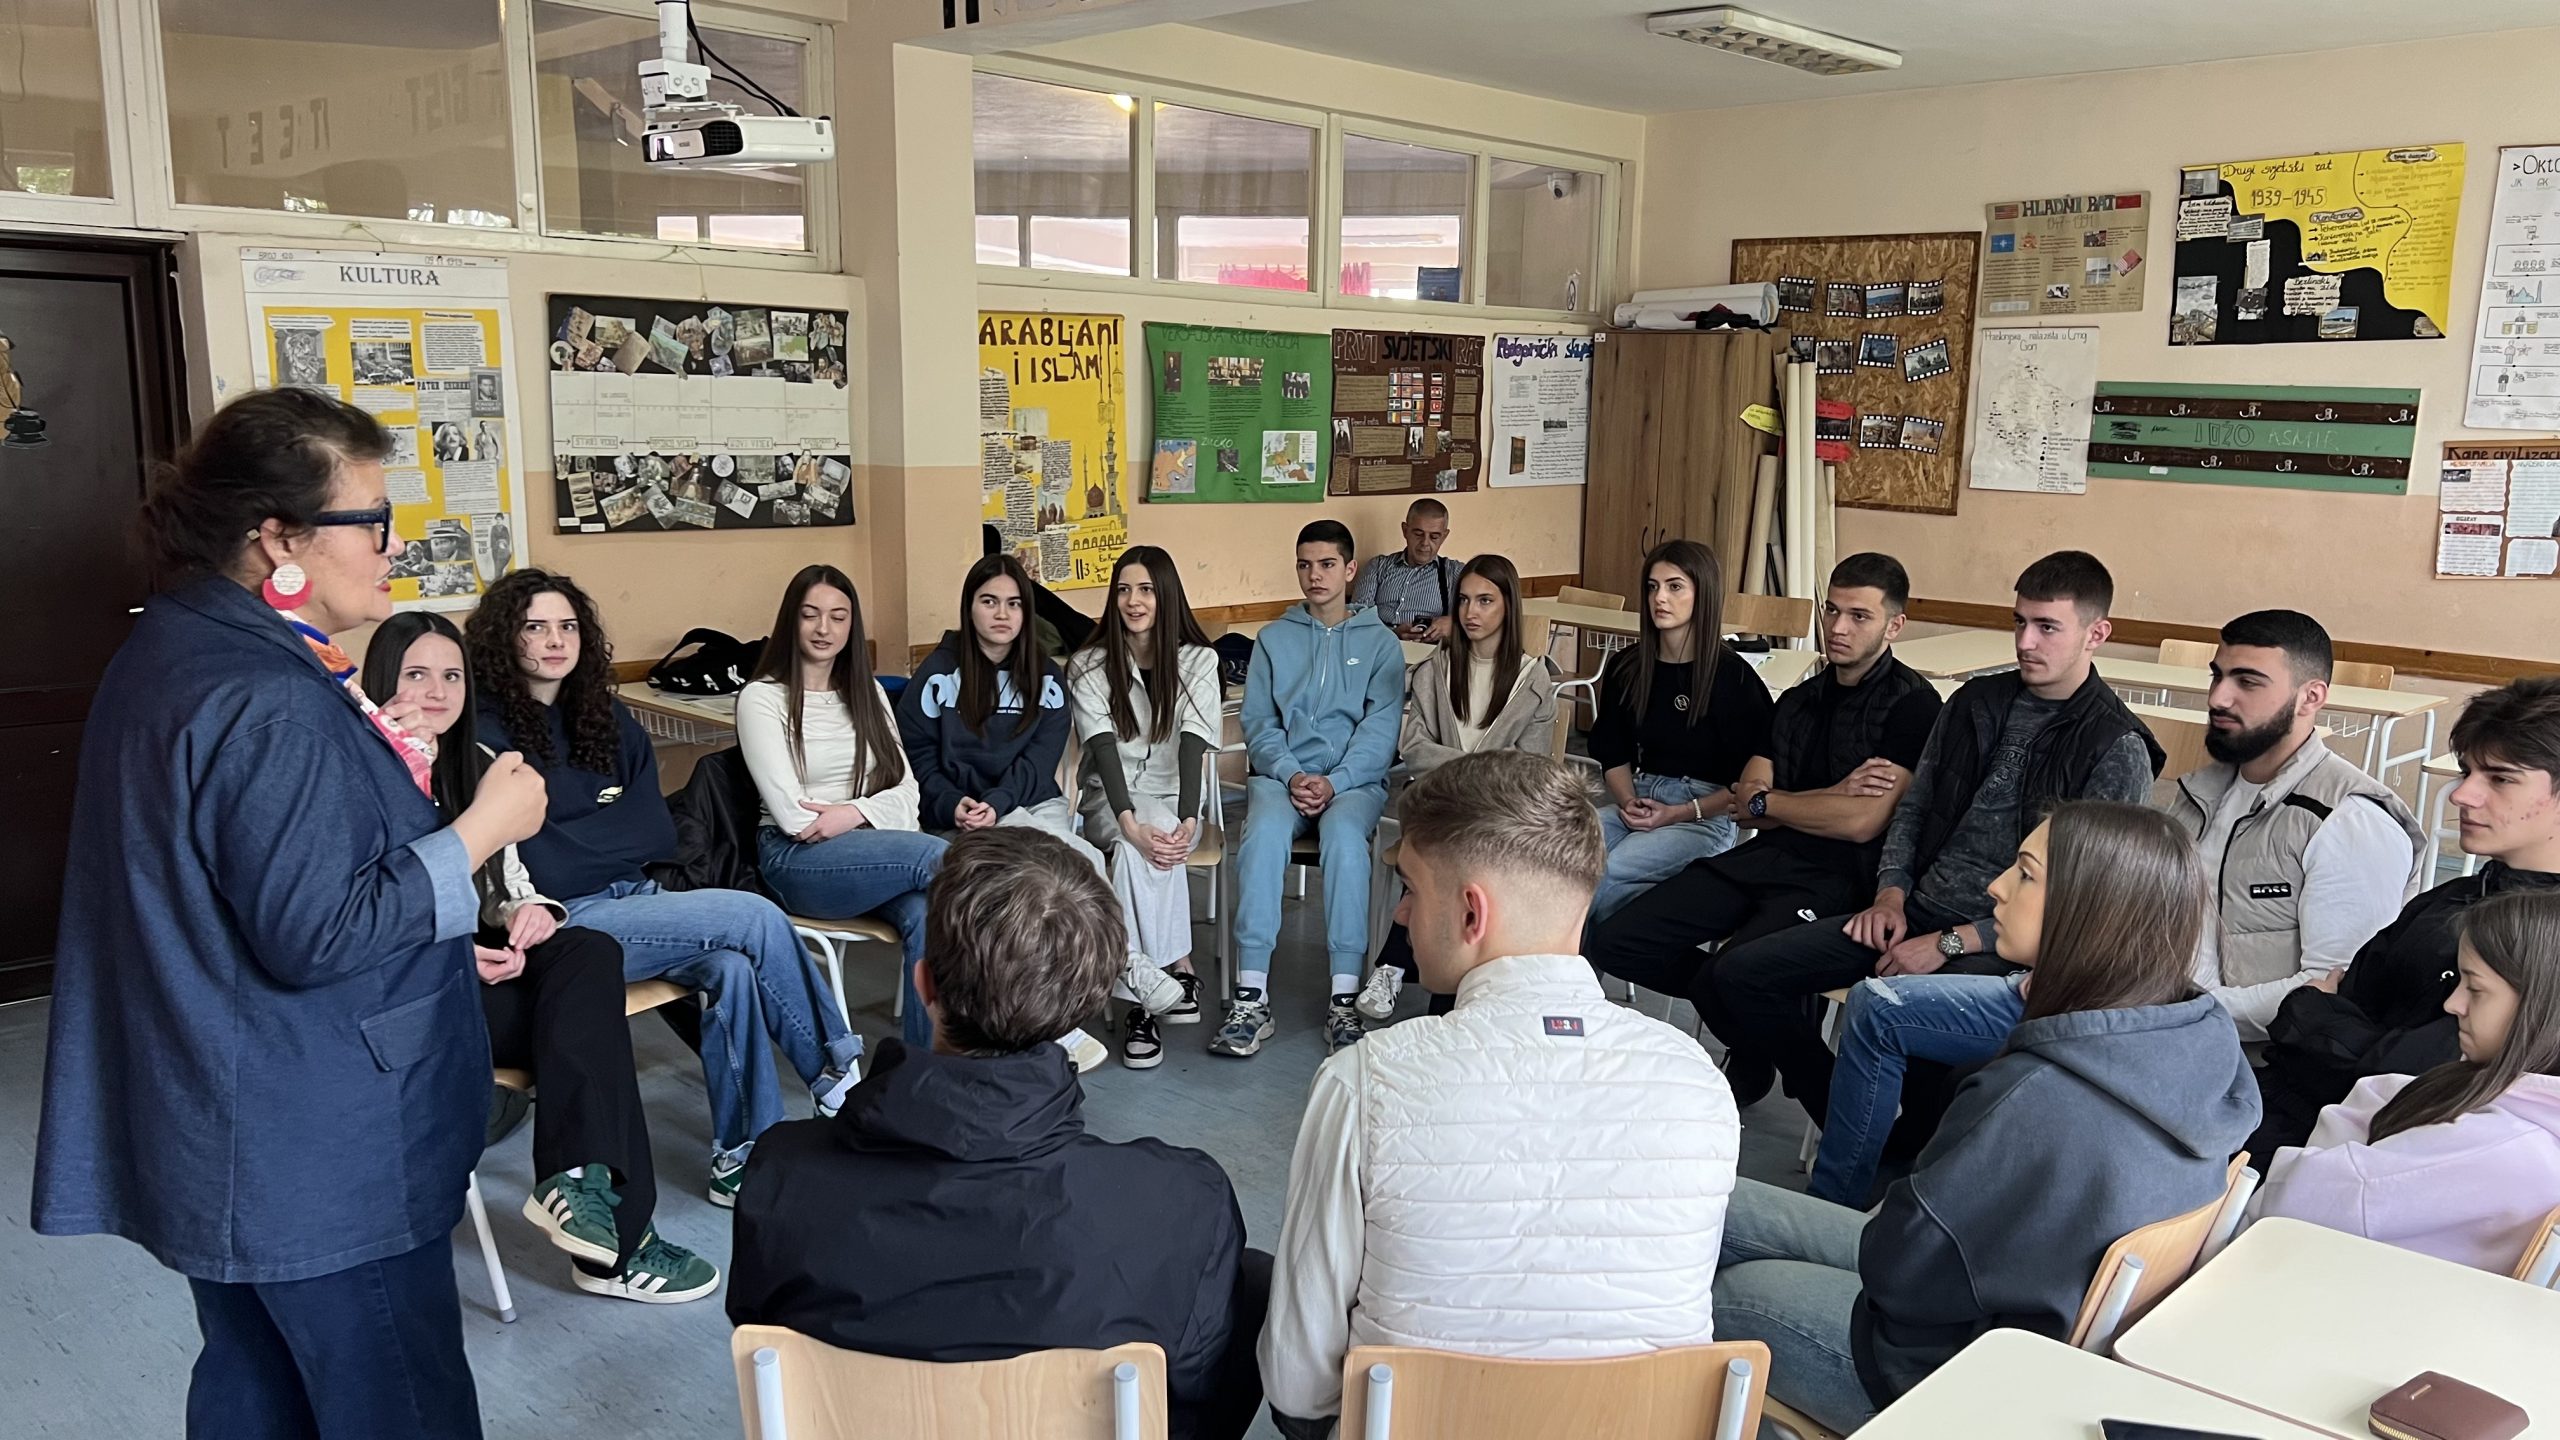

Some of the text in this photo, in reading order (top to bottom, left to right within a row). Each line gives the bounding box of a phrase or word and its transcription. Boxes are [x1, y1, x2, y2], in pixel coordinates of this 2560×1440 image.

[2022, 196, 2082, 218] HLADNI
[339, 265, 441, 286] KULTURA
[1333, 330, 1485, 367] PRVI SVJETSKI RAT
[1031, 351, 1101, 384] ISLAM
